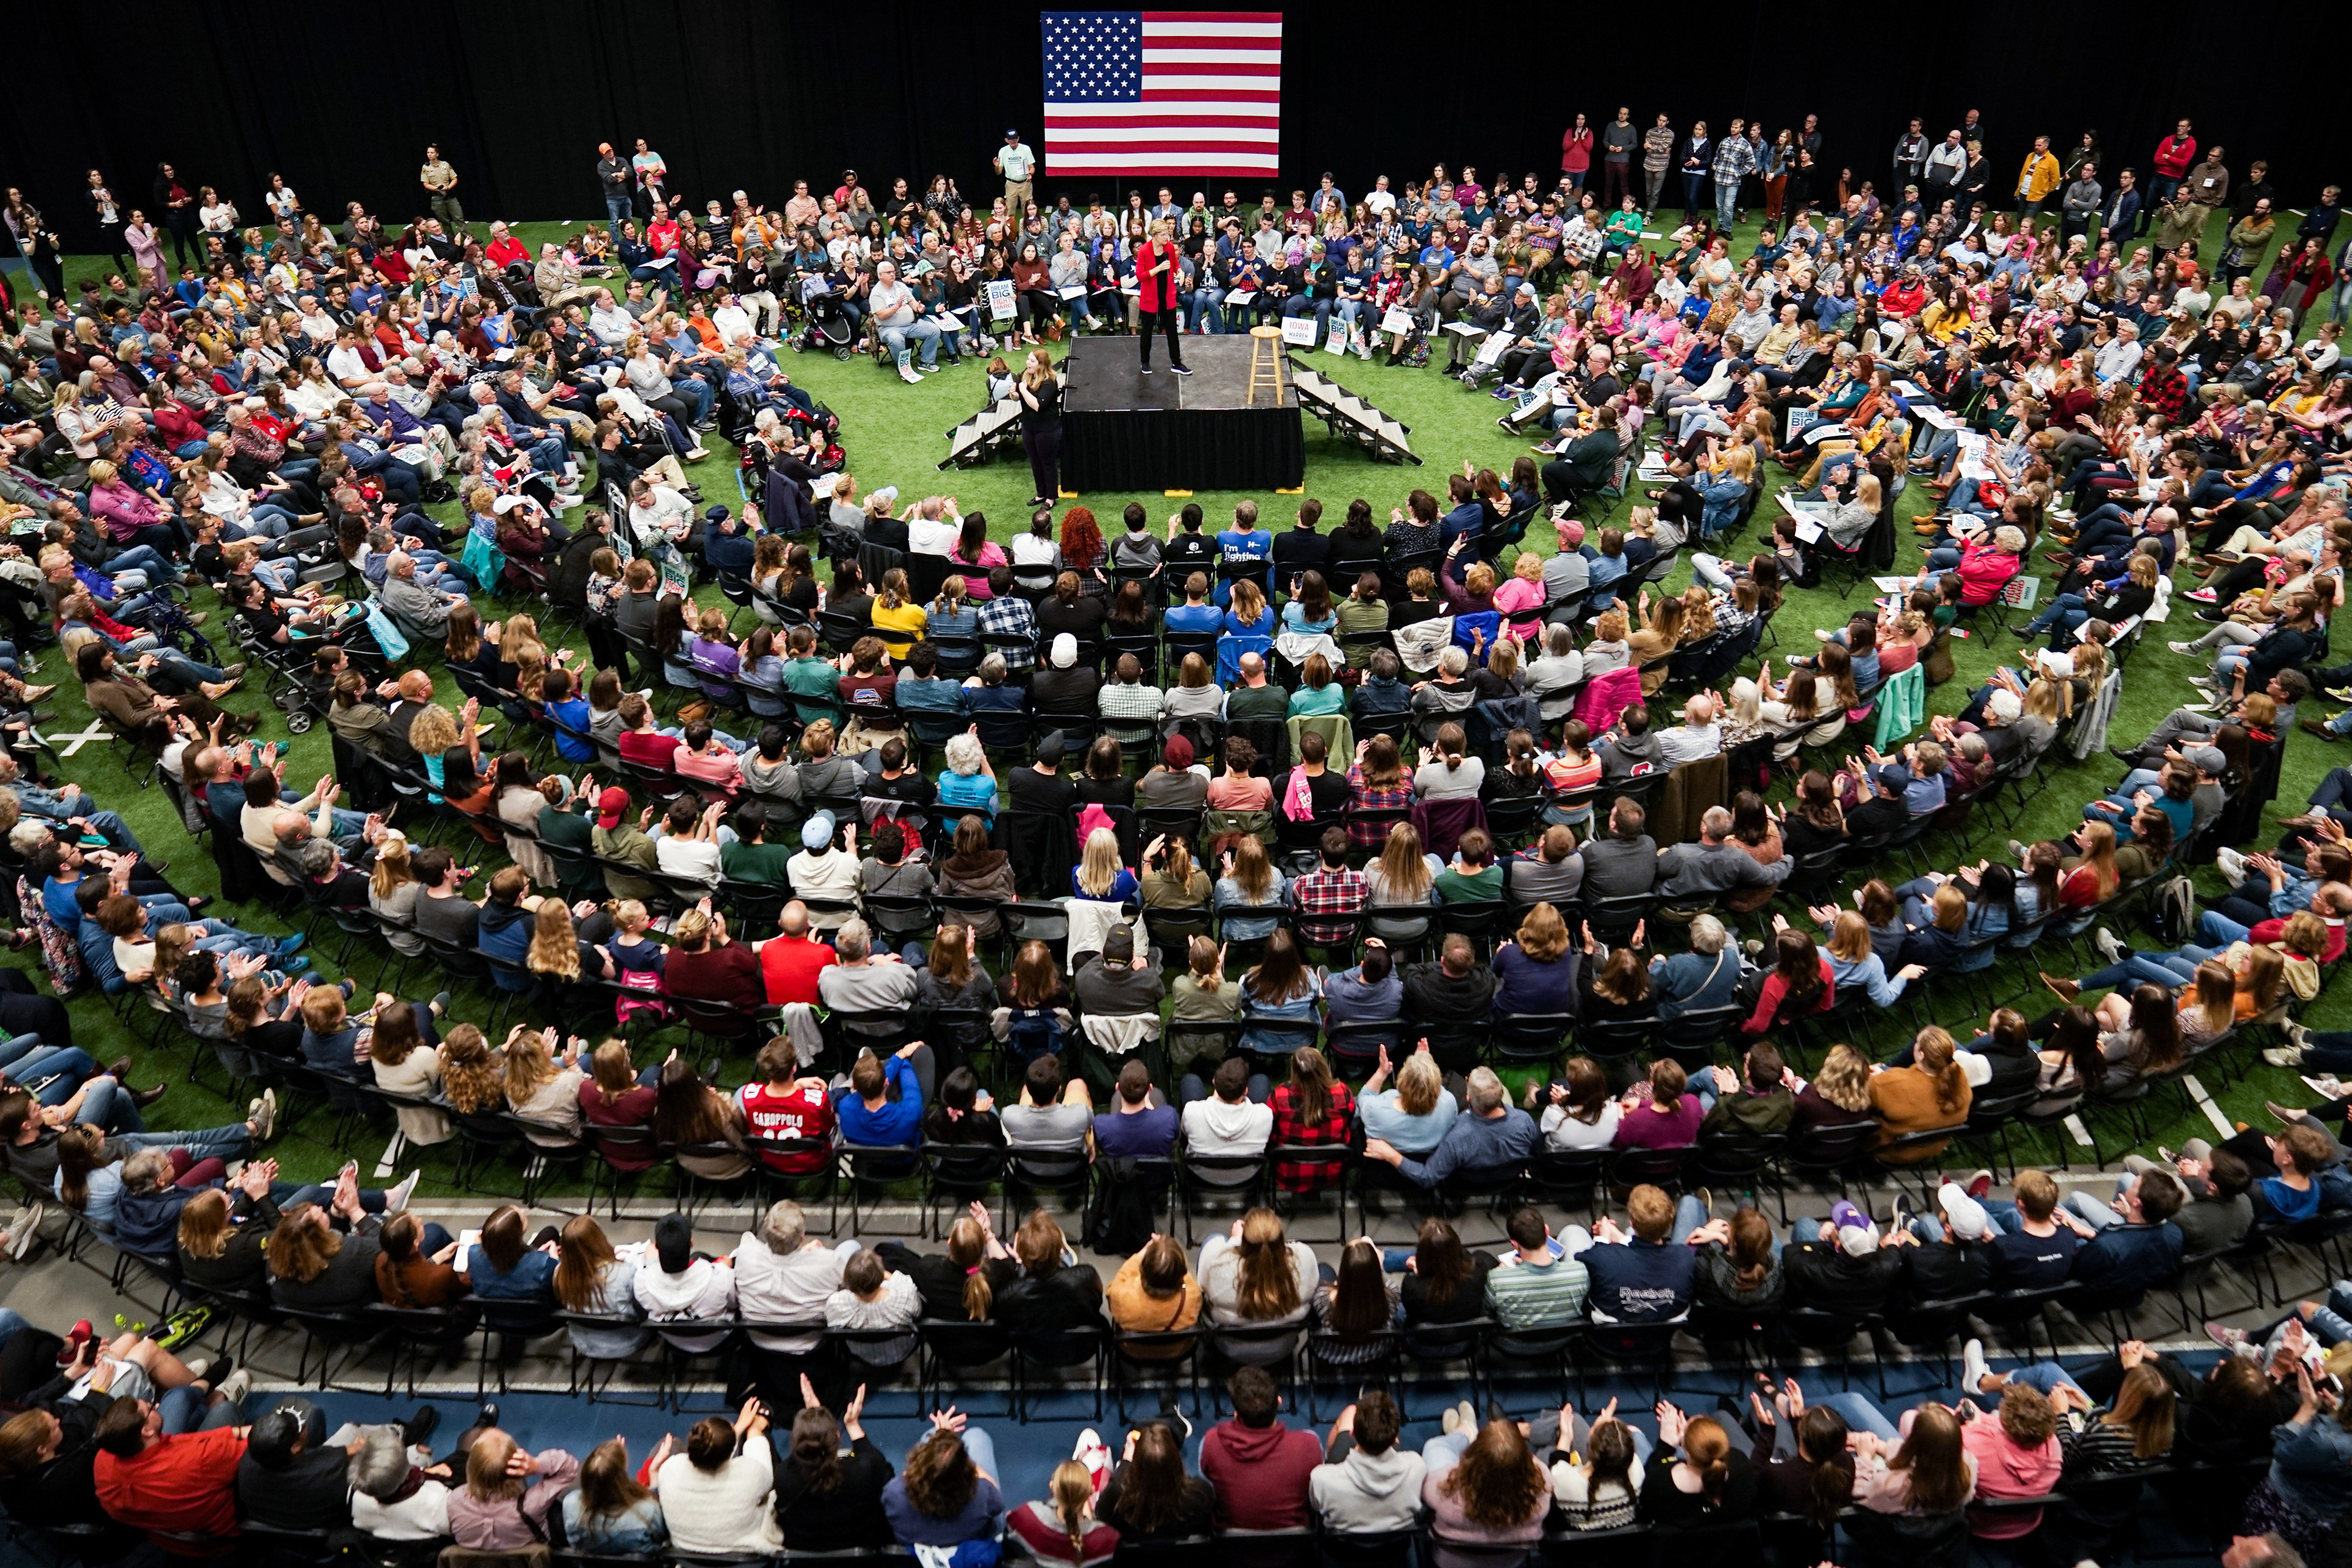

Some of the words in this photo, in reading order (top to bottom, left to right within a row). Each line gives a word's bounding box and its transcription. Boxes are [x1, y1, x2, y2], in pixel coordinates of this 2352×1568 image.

[992, 290, 1010, 299] BIG
[993, 297, 1012, 306] FIGHT
[1389, 311, 1408, 320] FIGHT
[1289, 322, 1309, 331] IOWA
[1331, 319, 1344, 328] DREAM
[1331, 325, 1345, 335] BIG
[1330, 331, 1345, 341] FIGHT
[1483, 338, 1500, 355] IOWA
[900, 358, 909, 367] BIG
[1540, 379, 1552, 390] BIG
[1966, 516, 1975, 528] BIG
[665, 572, 685, 588] BIG
[665, 578, 684, 595] FIGHT
[2015, 579, 2025, 604] HARD
[753, 1112, 803, 1128] GAROPPOLO
[1619, 1287, 1675, 1302] Reebok
